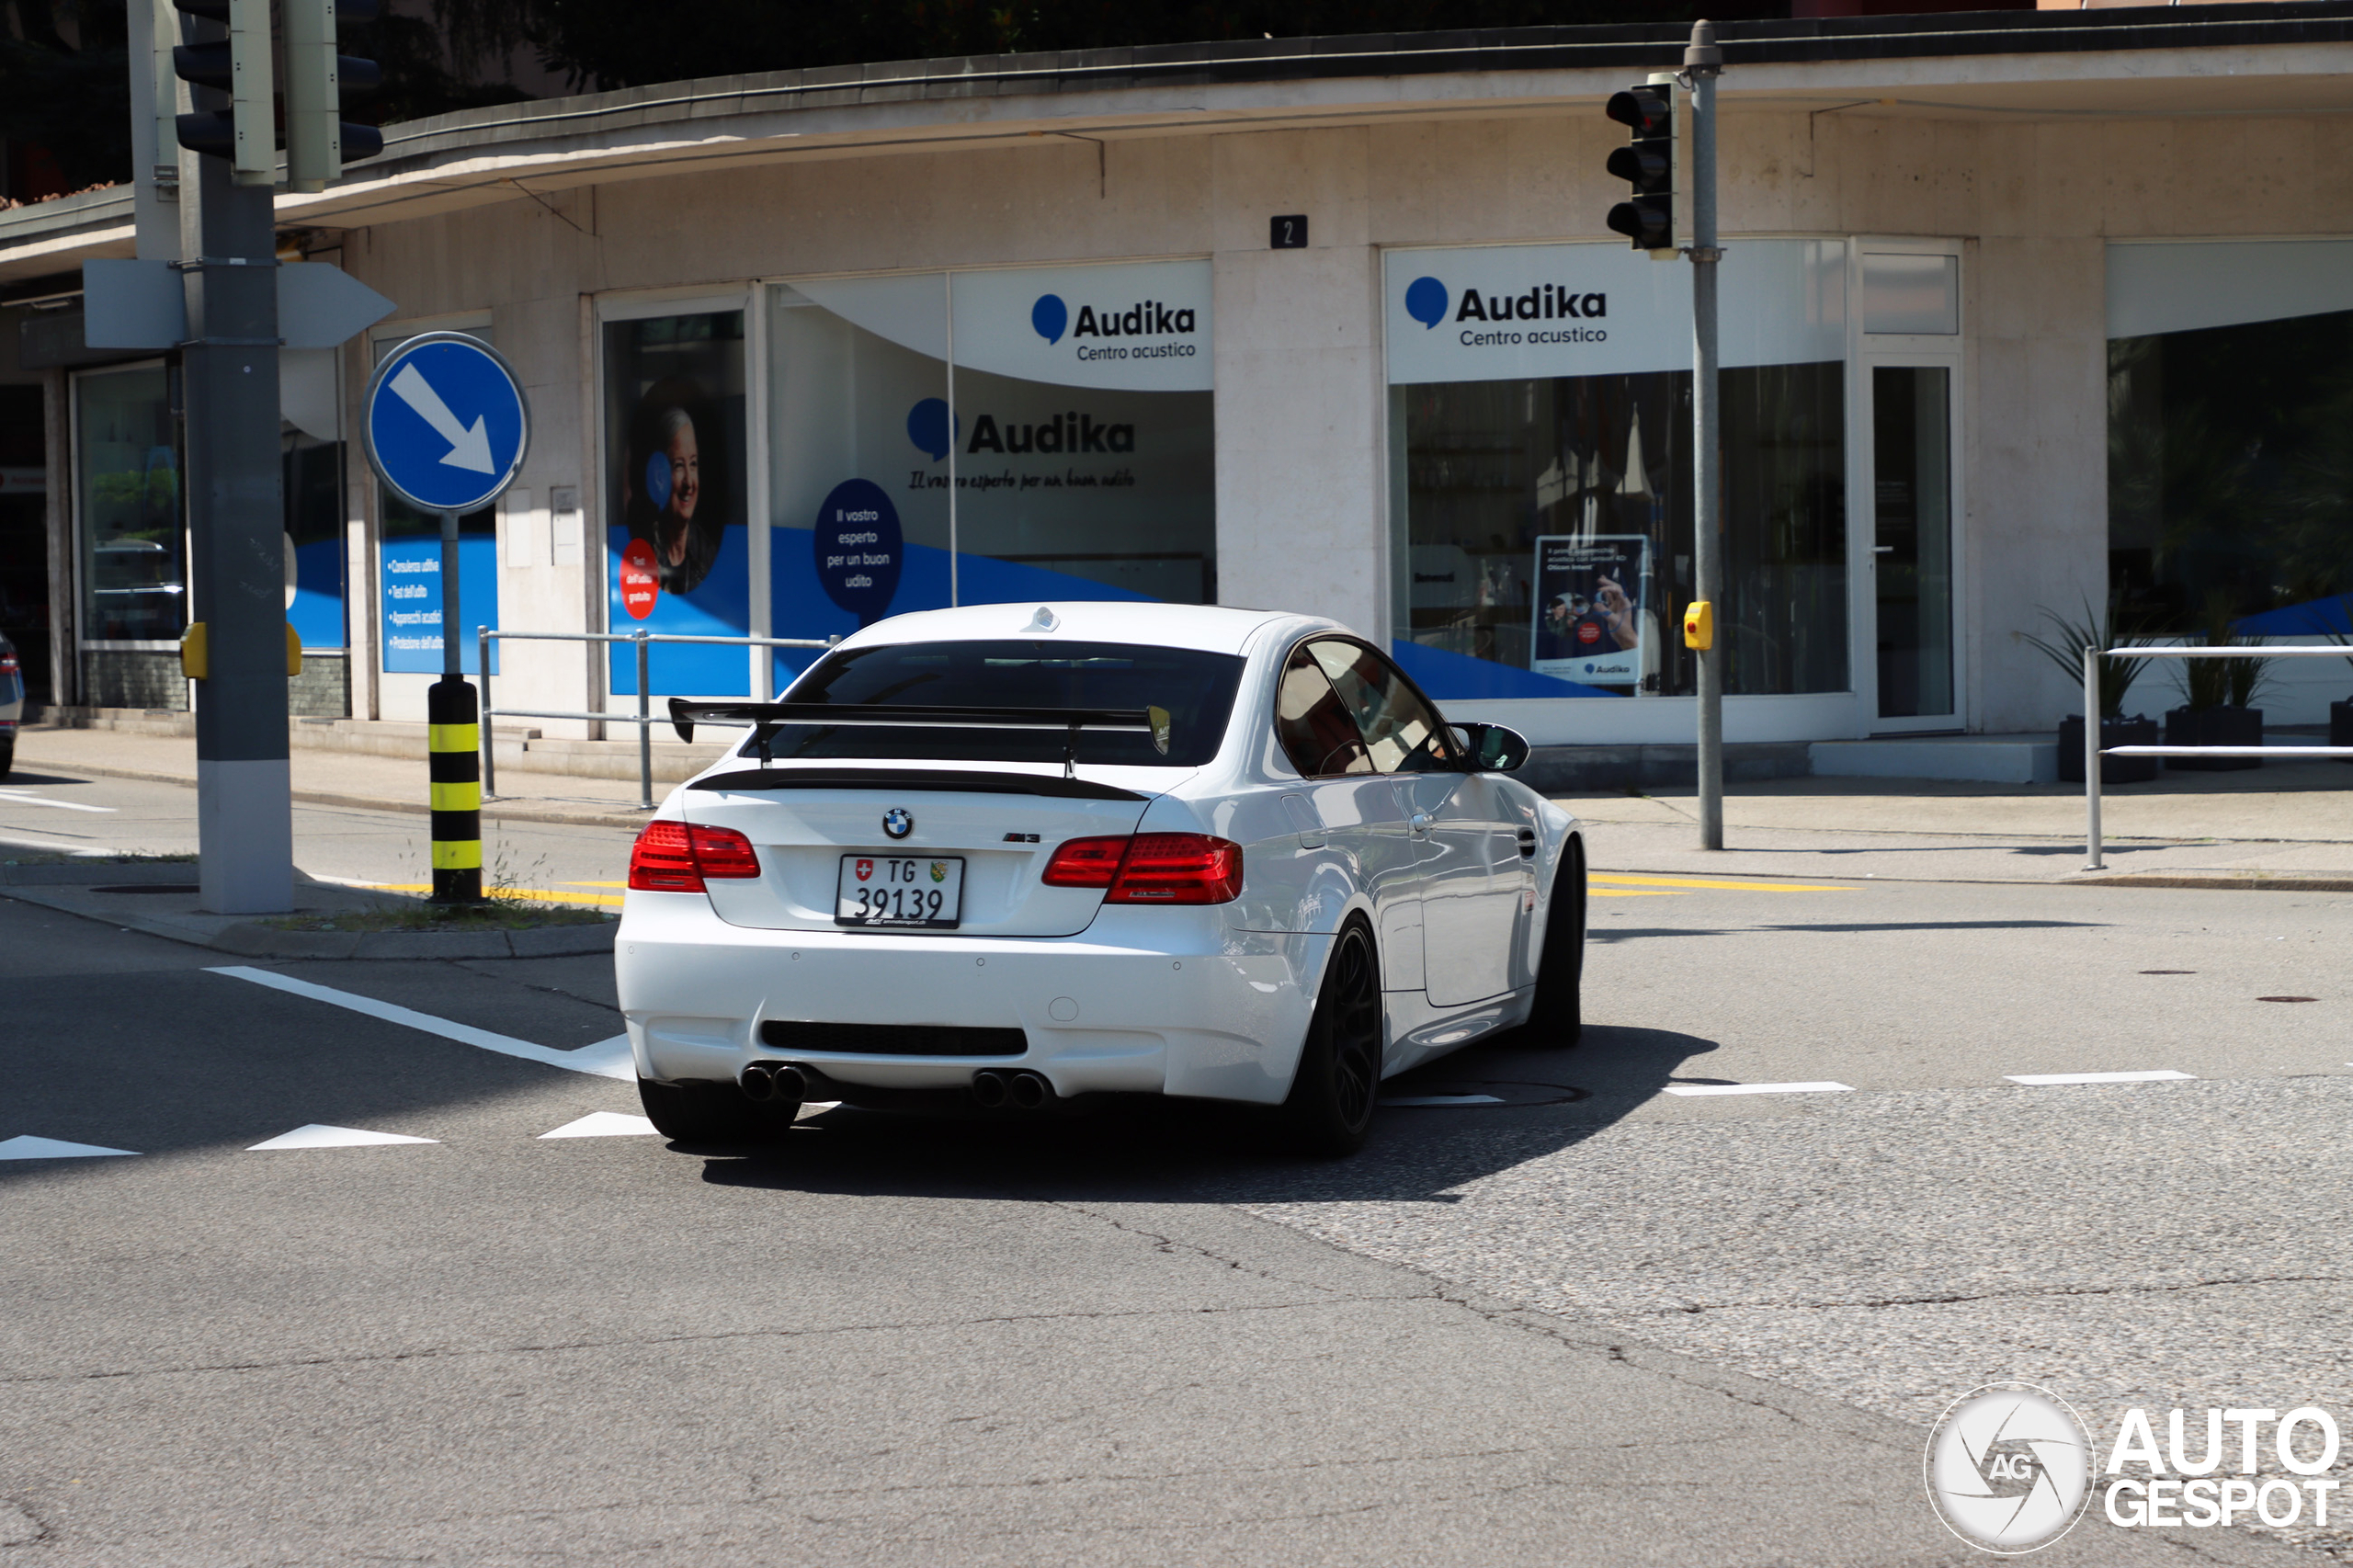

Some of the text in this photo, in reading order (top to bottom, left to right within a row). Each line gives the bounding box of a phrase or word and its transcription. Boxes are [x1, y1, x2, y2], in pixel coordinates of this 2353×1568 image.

[1284, 221, 1293, 244] 2
[1456, 283, 1607, 322] Audika
[1074, 300, 1195, 337] Audika
[1460, 326, 1608, 347] Centro acustico
[1077, 341, 1196, 360] Centro acustico
[968, 411, 1135, 454] Audika
[970, 470, 1015, 492] esperto
[1020, 472, 1041, 492] per
[836, 509, 879, 522] Il vostro
[838, 531, 878, 547] esperto
[827, 551, 890, 569] per un buon
[846, 574, 872, 587] udito
[1596, 665, 1630, 674] Audika
[1003, 833, 1040, 843] M3
[888, 860, 916, 883] TG
[854, 887, 943, 919] 39139
